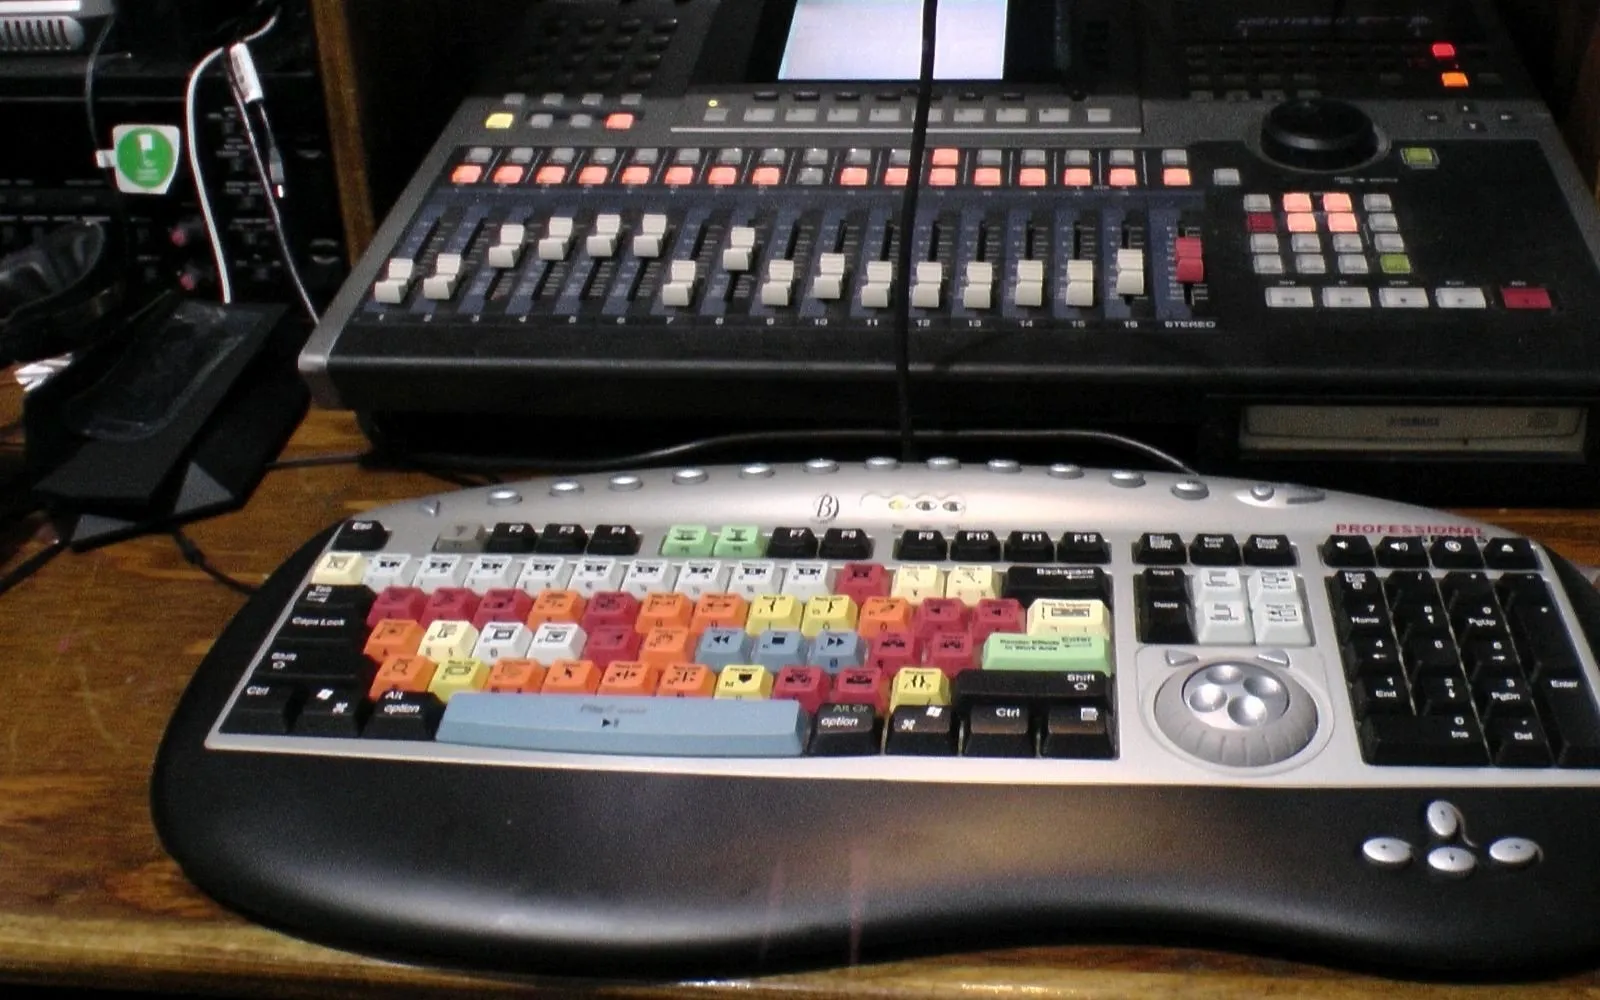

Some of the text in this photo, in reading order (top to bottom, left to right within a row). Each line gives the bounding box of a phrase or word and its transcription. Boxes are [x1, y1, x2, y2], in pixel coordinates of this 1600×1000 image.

[1164, 320, 1216, 329] STEREO
[559, 525, 575, 534] F3
[789, 528, 806, 539] F7
[1334, 523, 1483, 537] PROFESSIONAL
[966, 532, 990, 542] F10
[1021, 533, 1043, 543] F11
[1073, 534, 1097, 544] F12
[291, 616, 320, 627] Caps
[1067, 673, 1096, 683] Shift
[384, 690, 404, 701] Alt
[383, 703, 420, 715] option
[995, 707, 1021, 719] Ctrl
[820, 717, 859, 729] option
